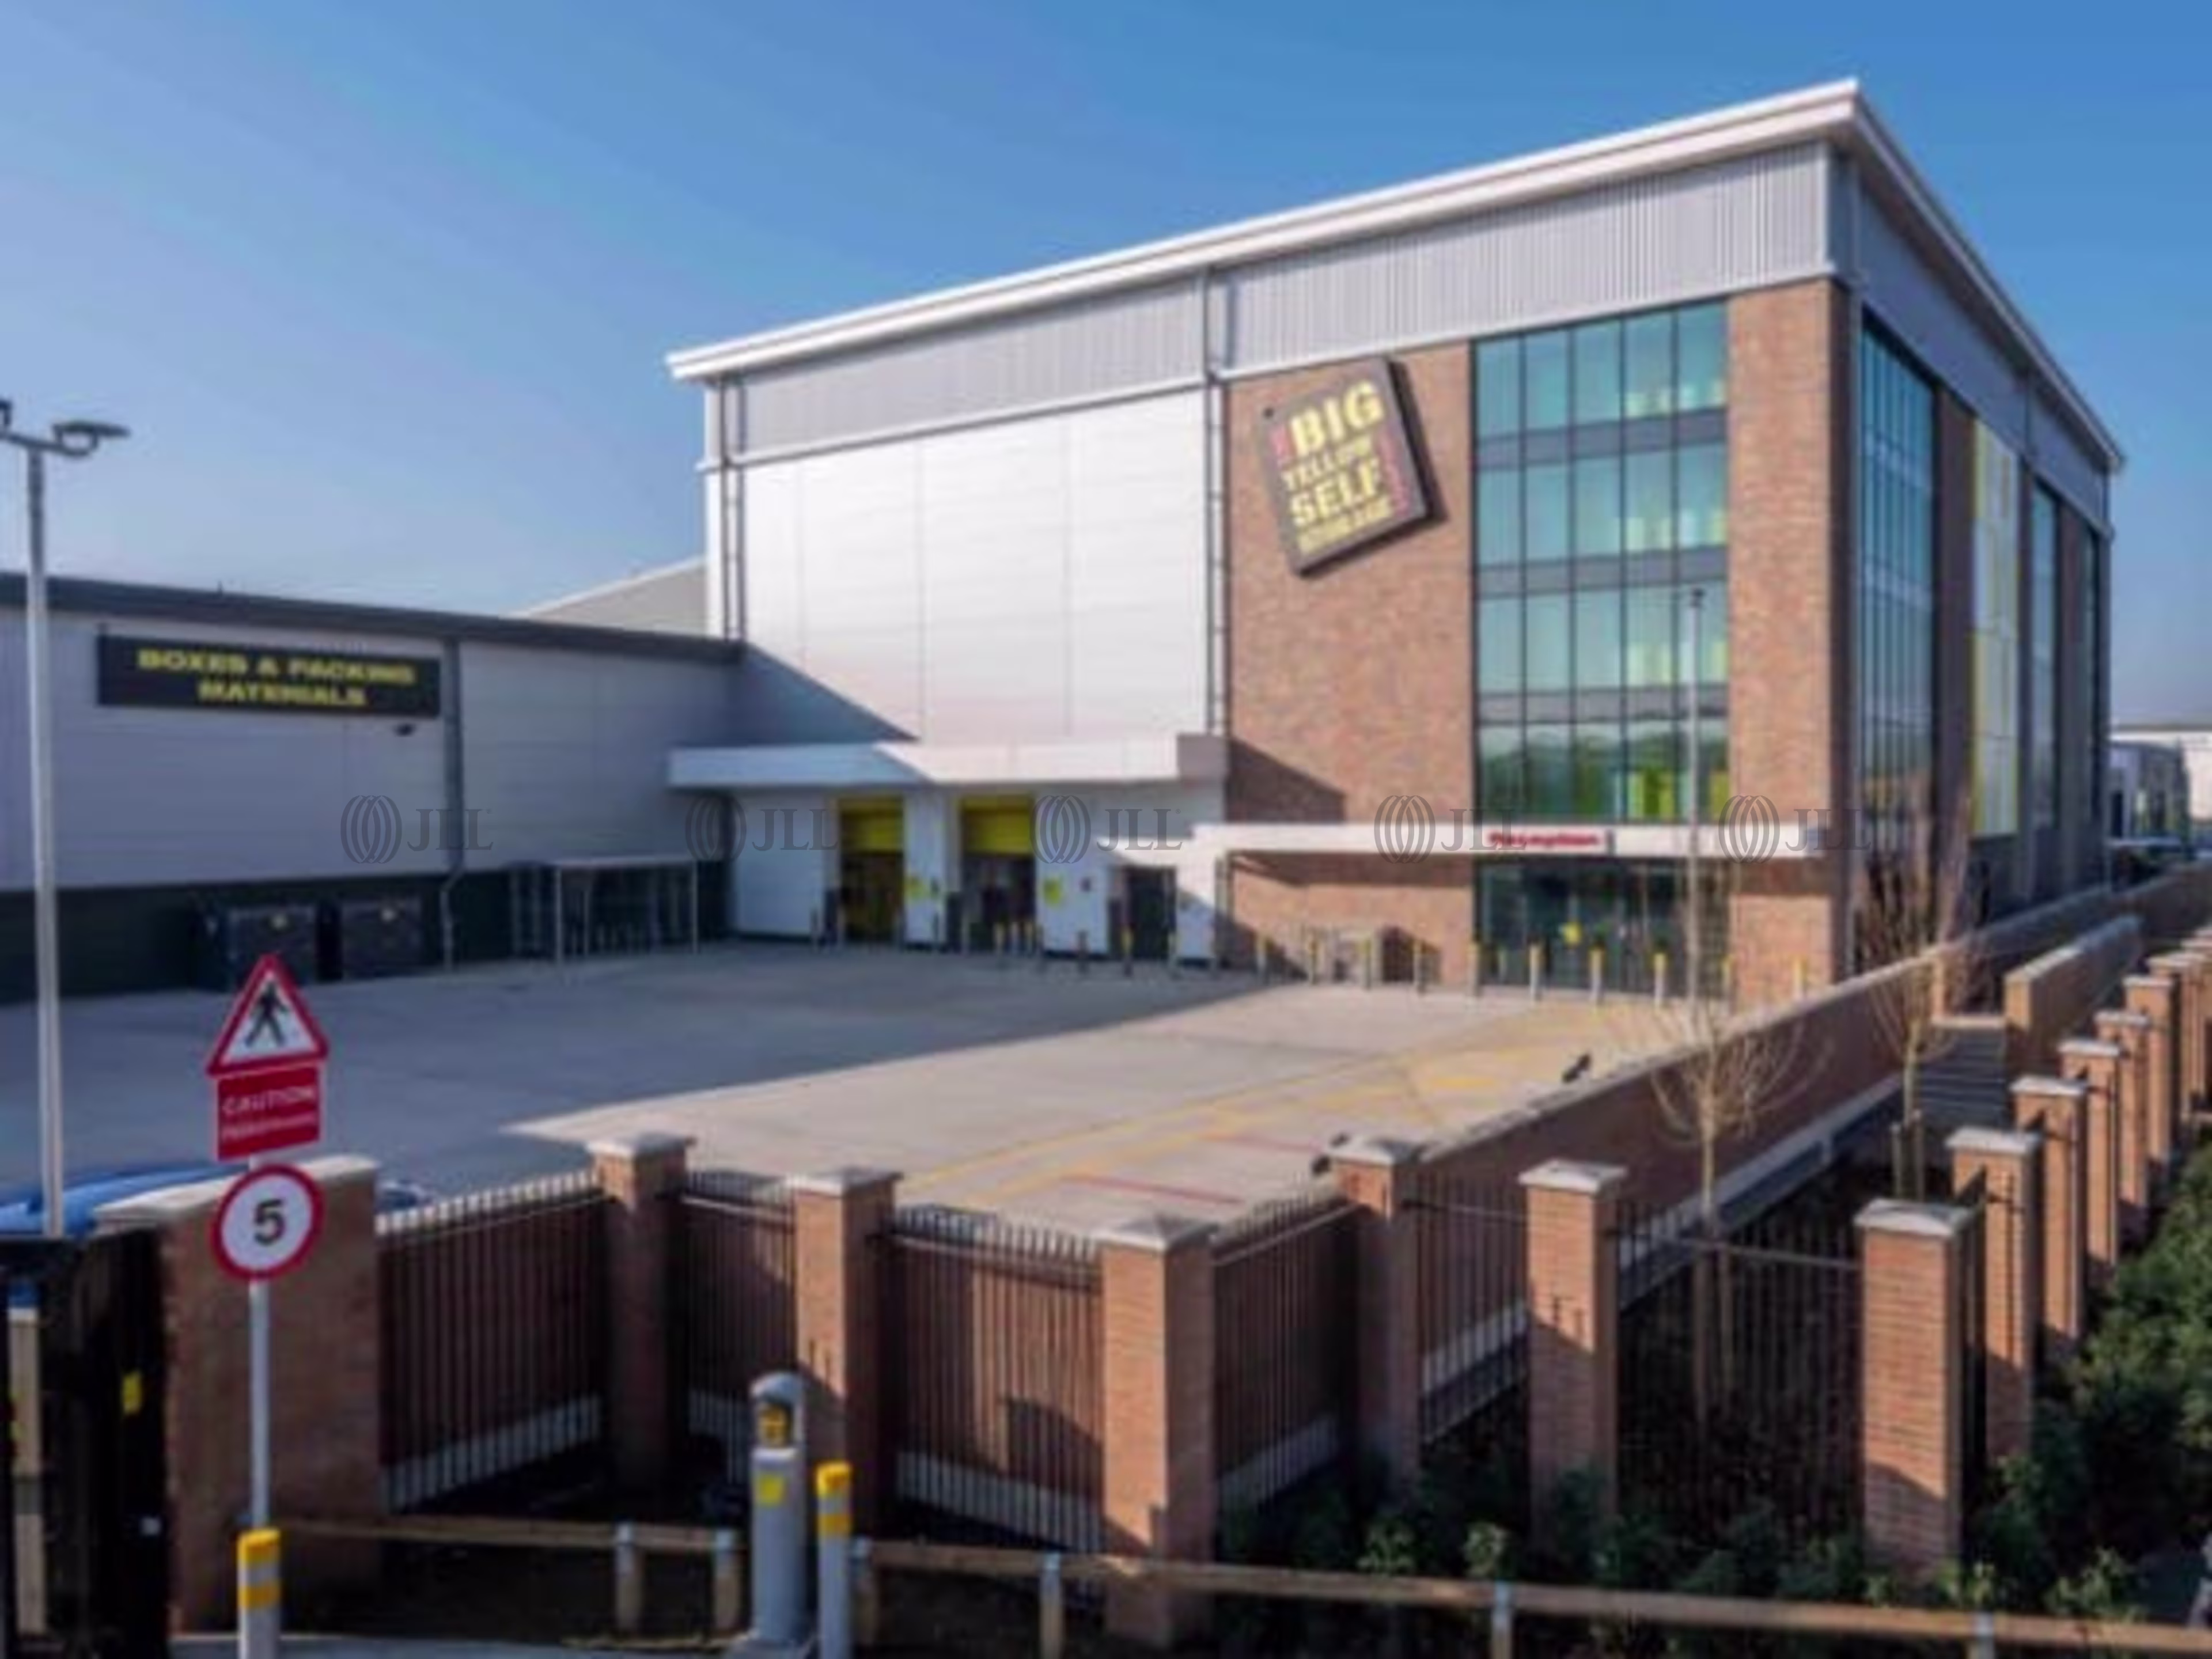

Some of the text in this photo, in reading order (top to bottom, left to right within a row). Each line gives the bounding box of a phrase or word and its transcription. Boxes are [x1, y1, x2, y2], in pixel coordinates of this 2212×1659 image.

[1290, 379, 1384, 457] BIG
[1290, 458, 1382, 528] SELF
[137, 649, 248, 675] BOXES
[253, 1198, 286, 1247] 5
